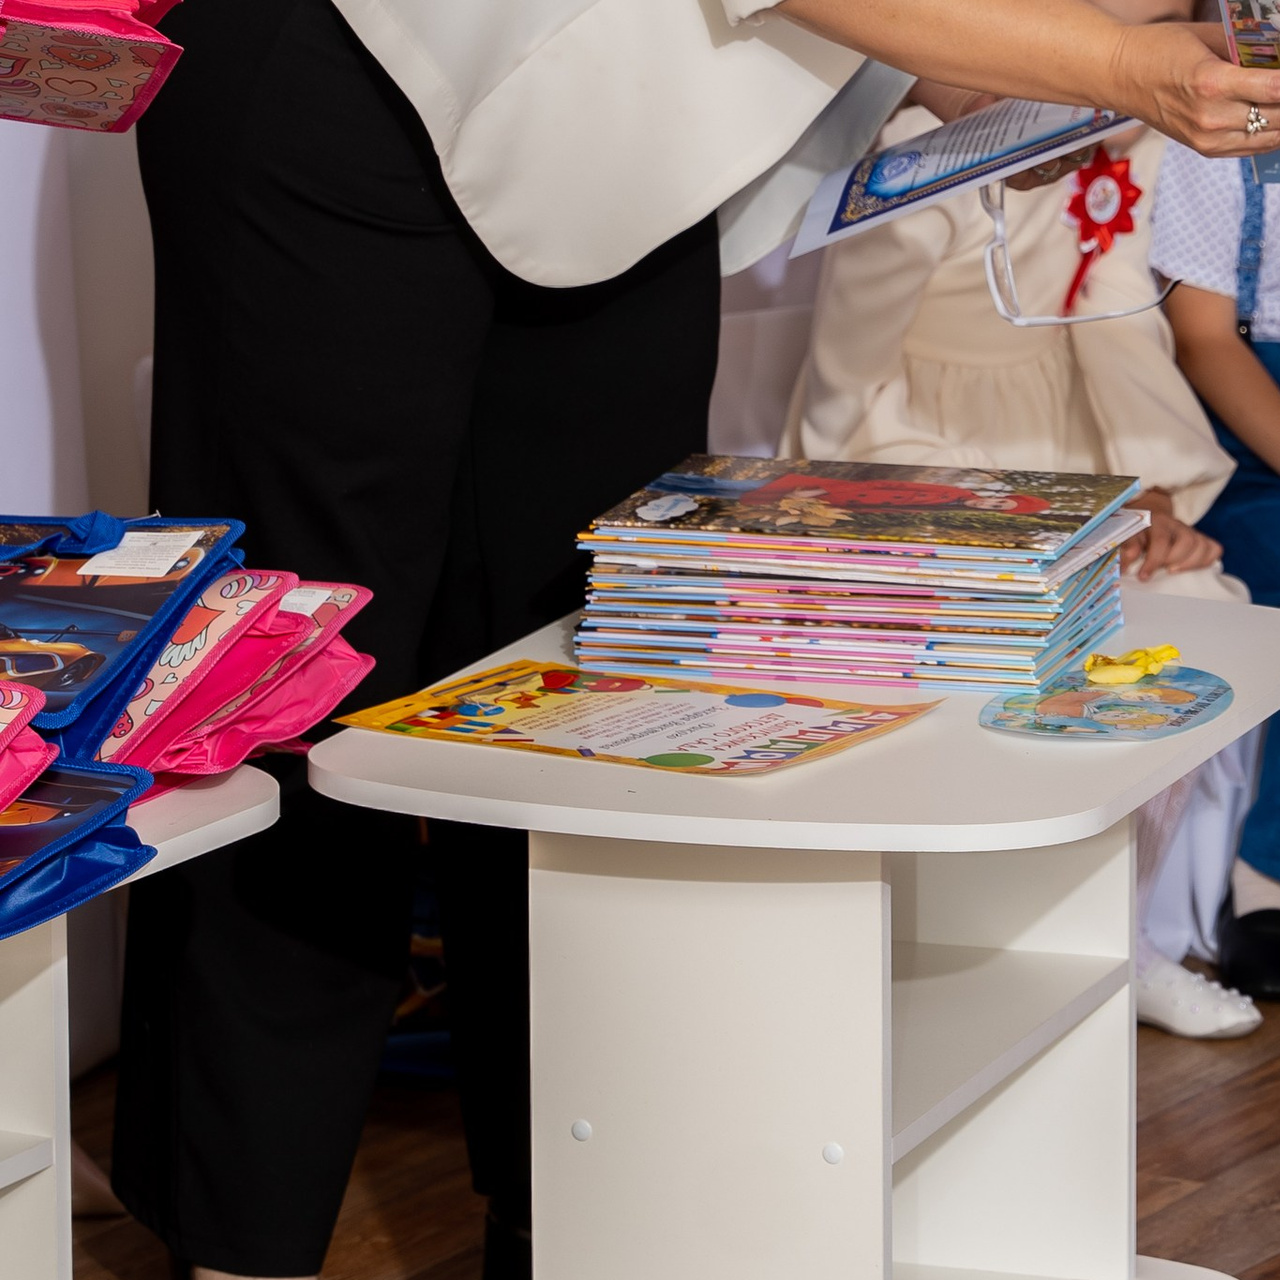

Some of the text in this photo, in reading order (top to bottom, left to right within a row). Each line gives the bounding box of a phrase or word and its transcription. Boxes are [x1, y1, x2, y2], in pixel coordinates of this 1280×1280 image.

[706, 720, 804, 751] ВЫПУСКНИКА
[714, 713, 786, 738] ДЕТСКОГО
[667, 737, 717, 752] САДА
[729, 712, 900, 770] ДИПЛОМ
